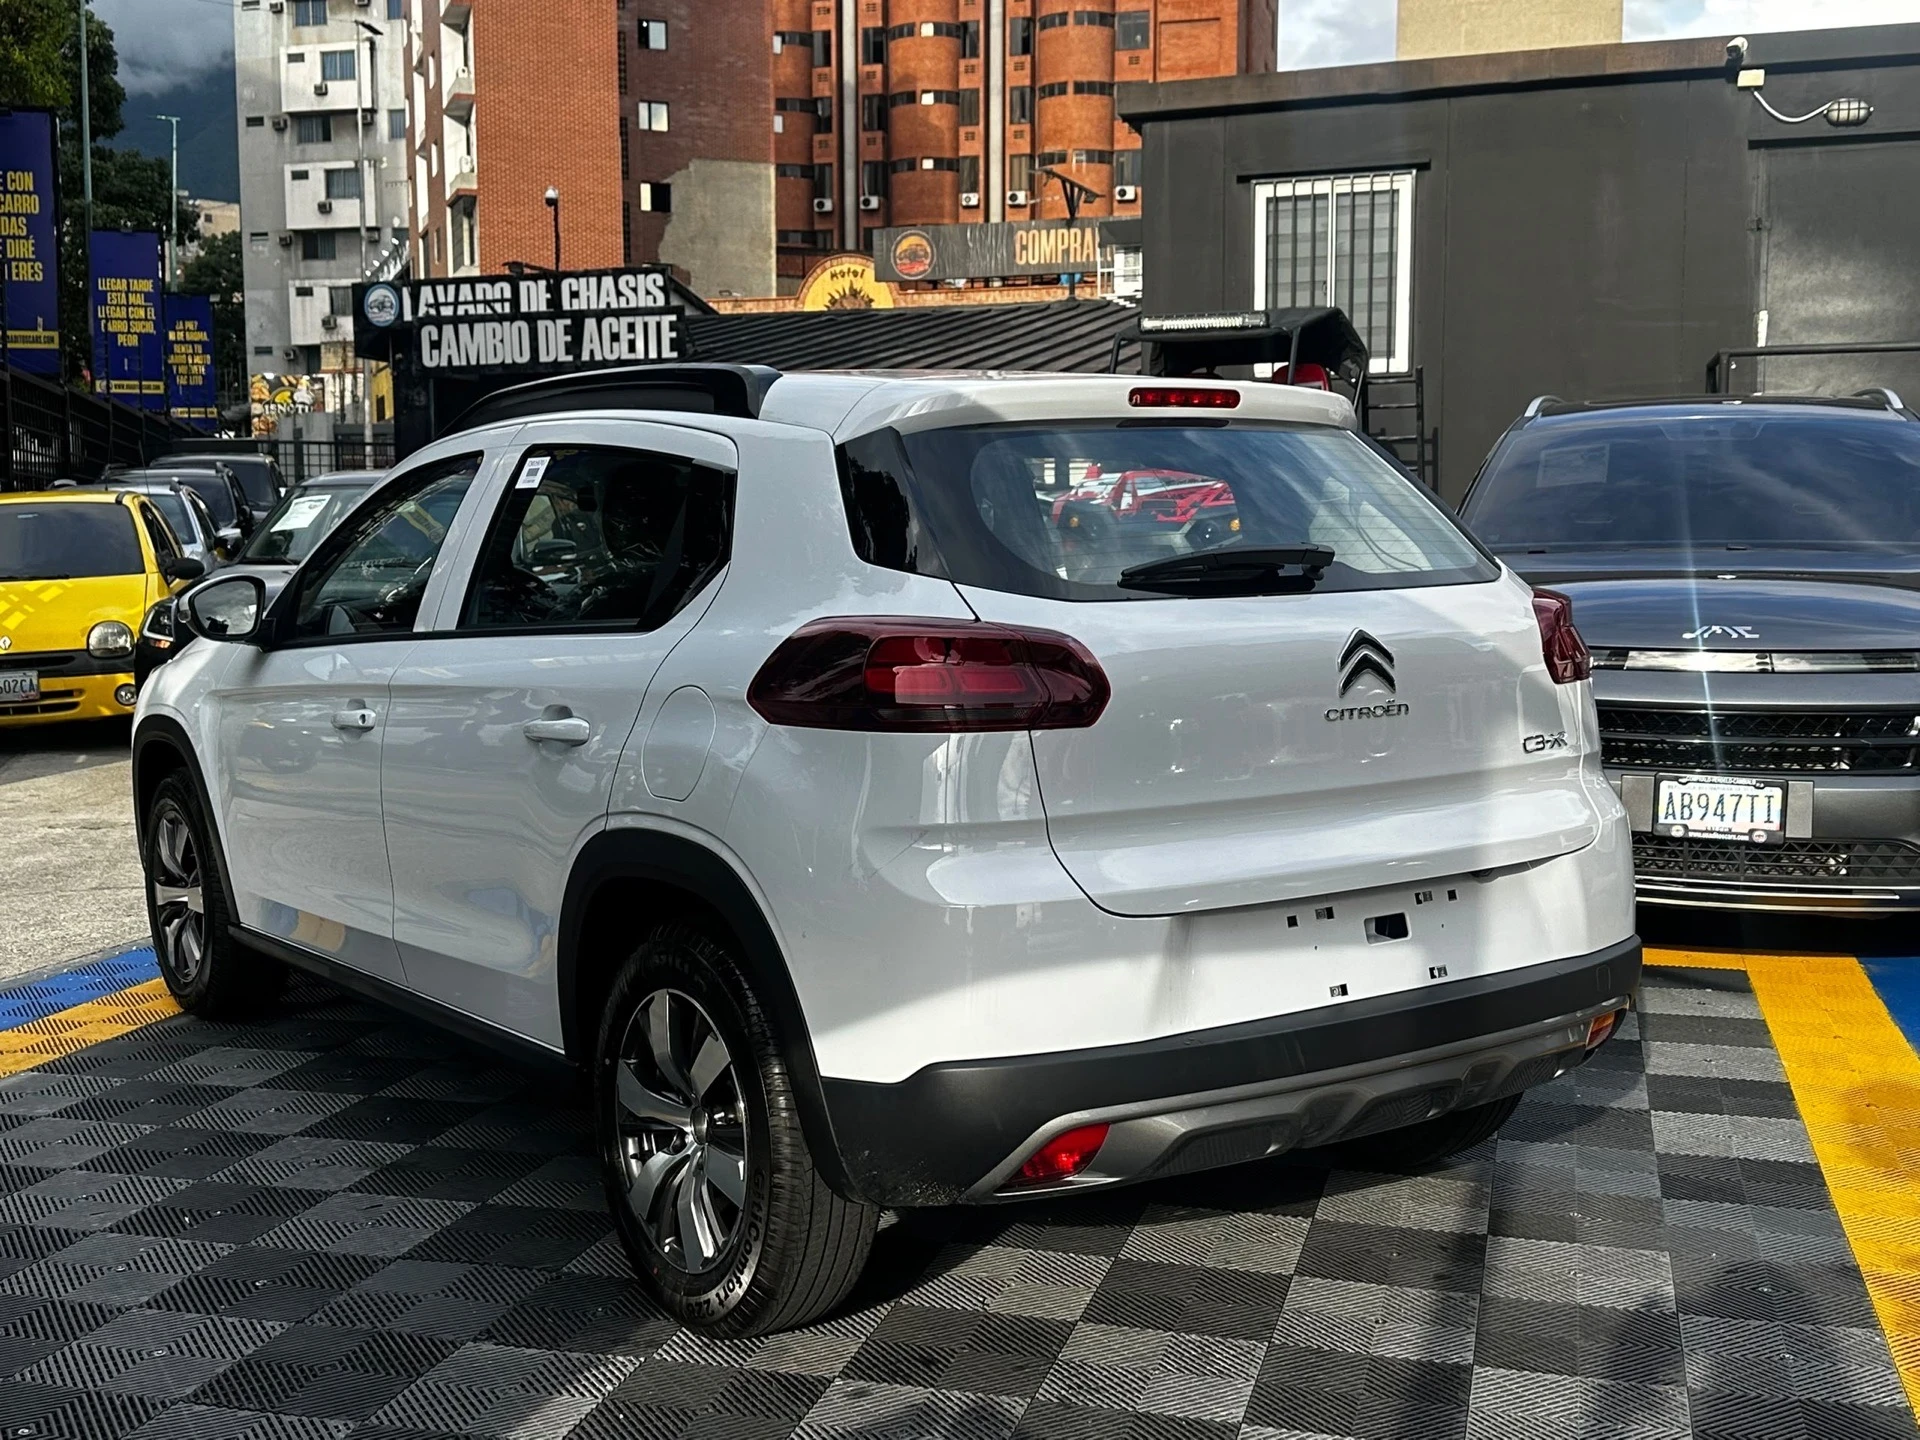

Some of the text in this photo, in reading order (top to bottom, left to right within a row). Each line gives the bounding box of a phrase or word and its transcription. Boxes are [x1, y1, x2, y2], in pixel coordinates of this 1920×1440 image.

[7, 171, 34, 192] CON
[0, 216, 28, 237] DAS
[6, 235, 36, 259] DIRÉ
[12, 261, 43, 282] ERES
[98, 278, 154, 292] LLEGAR TARDE
[561, 273, 666, 310] CHASIS
[128, 306, 145, 319] CON
[117, 333, 139, 347] PEOR
[421, 314, 679, 368] CAMBIO DE ACEITE
[1664, 791, 1775, 823] AB947TI
